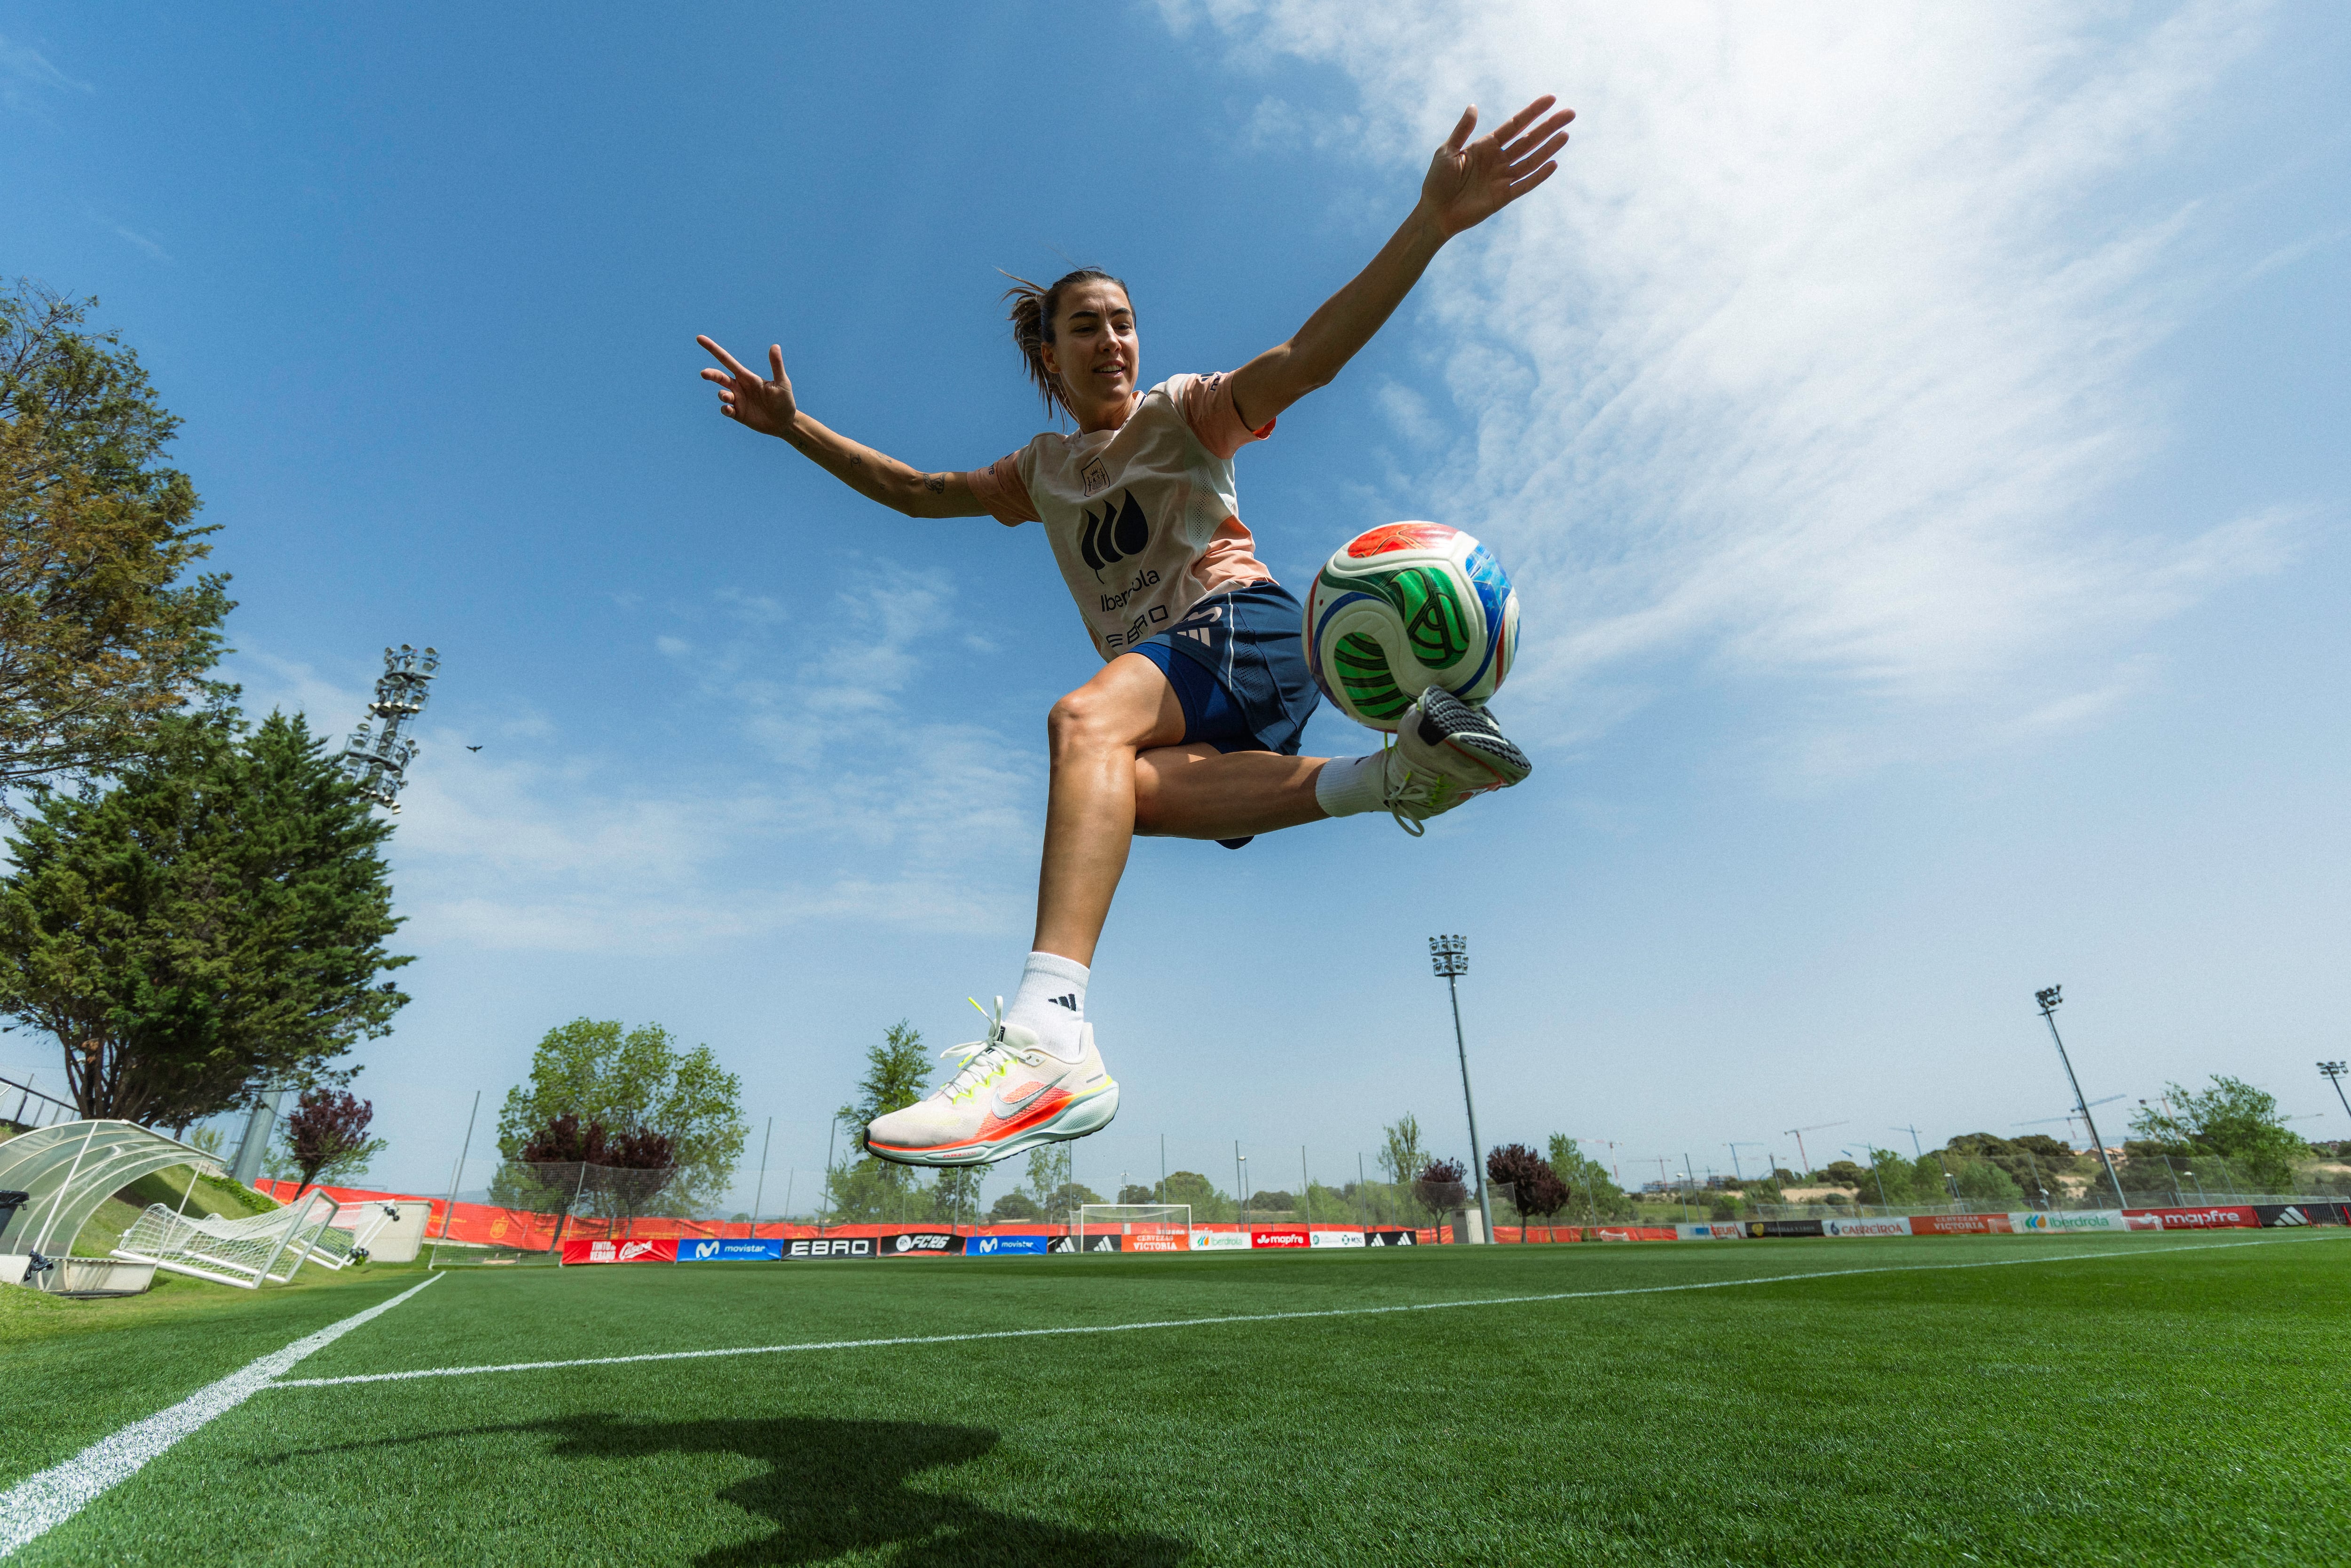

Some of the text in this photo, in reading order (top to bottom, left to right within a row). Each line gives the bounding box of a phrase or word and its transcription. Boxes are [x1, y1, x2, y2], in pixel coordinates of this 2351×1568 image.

[1101, 569, 1160, 612] Iberola
[2049, 1215, 2109, 1228] Iberdrola
[2165, 1210, 2240, 1225] mapfre
[1934, 1221, 1985, 1230] VICTORIA
[1211, 1237, 1243, 1245] Iberdrola
[1270, 1234, 1304, 1245] mapfre
[724, 1244, 766, 1253] movistar
[790, 1240, 869, 1256] EBRO
[1133, 1242, 1177, 1251] VICTORIA
